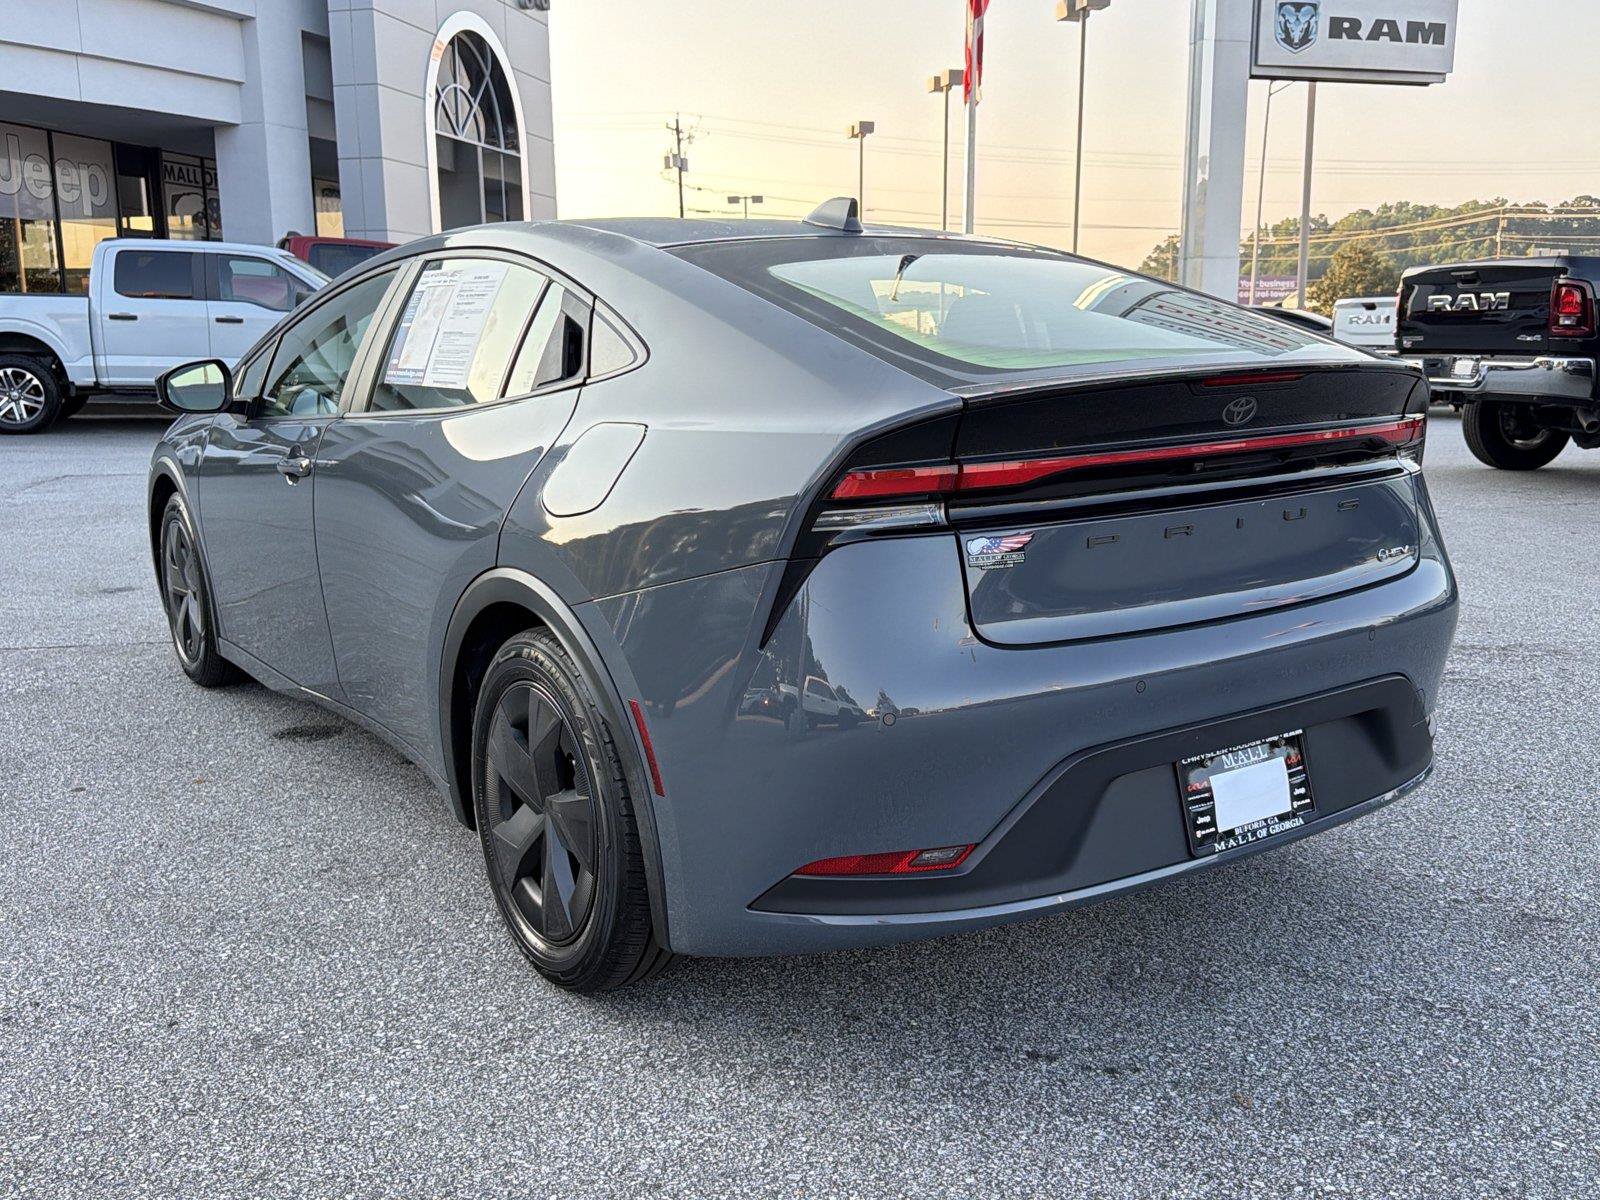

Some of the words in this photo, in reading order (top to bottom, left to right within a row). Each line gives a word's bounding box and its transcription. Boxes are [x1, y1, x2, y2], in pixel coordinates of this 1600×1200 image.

[1328, 16, 1446, 46] RAM
[0, 133, 109, 216] Jeep
[163, 164, 200, 185] MALL
[1427, 292, 1510, 312] RAM
[1348, 315, 1391, 325] RAM
[1087, 498, 1360, 549] PRIUS
[1256, 827, 1268, 840] OF
[1269, 817, 1305, 835] GEORGIA
[1268, 816, 1279, 825] GA
